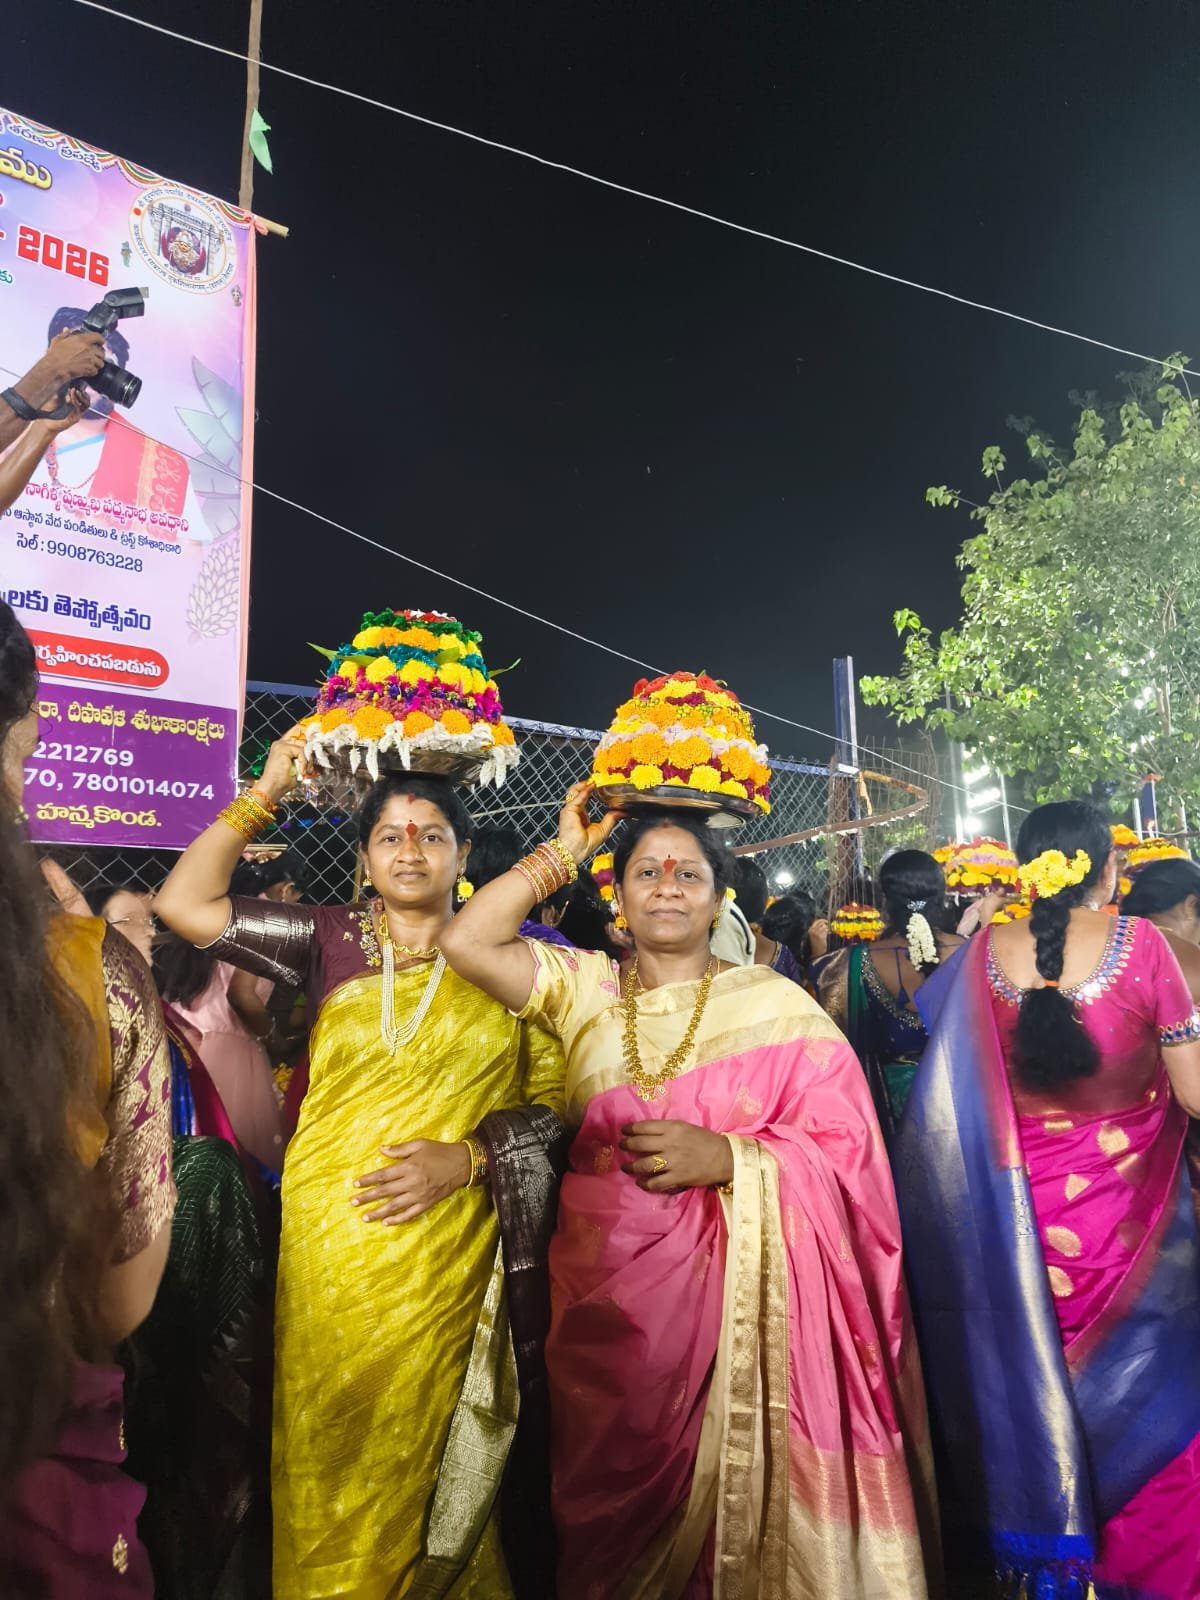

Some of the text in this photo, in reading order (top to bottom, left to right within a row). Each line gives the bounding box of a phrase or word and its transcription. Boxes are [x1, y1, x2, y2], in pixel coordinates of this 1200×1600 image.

[18, 225, 109, 287] 2026
[45, 513, 62, 528] వేద
[64, 520, 108, 538] పండితులు
[110, 528, 118, 540] &
[47, 540, 143, 573] 9908763228
[2, 590, 48, 612] లకు
[35, 644, 161, 677] ర్వహించపబడును
[38, 701, 62, 722] రా,
[23, 767, 215, 800] 70, 7801014074
